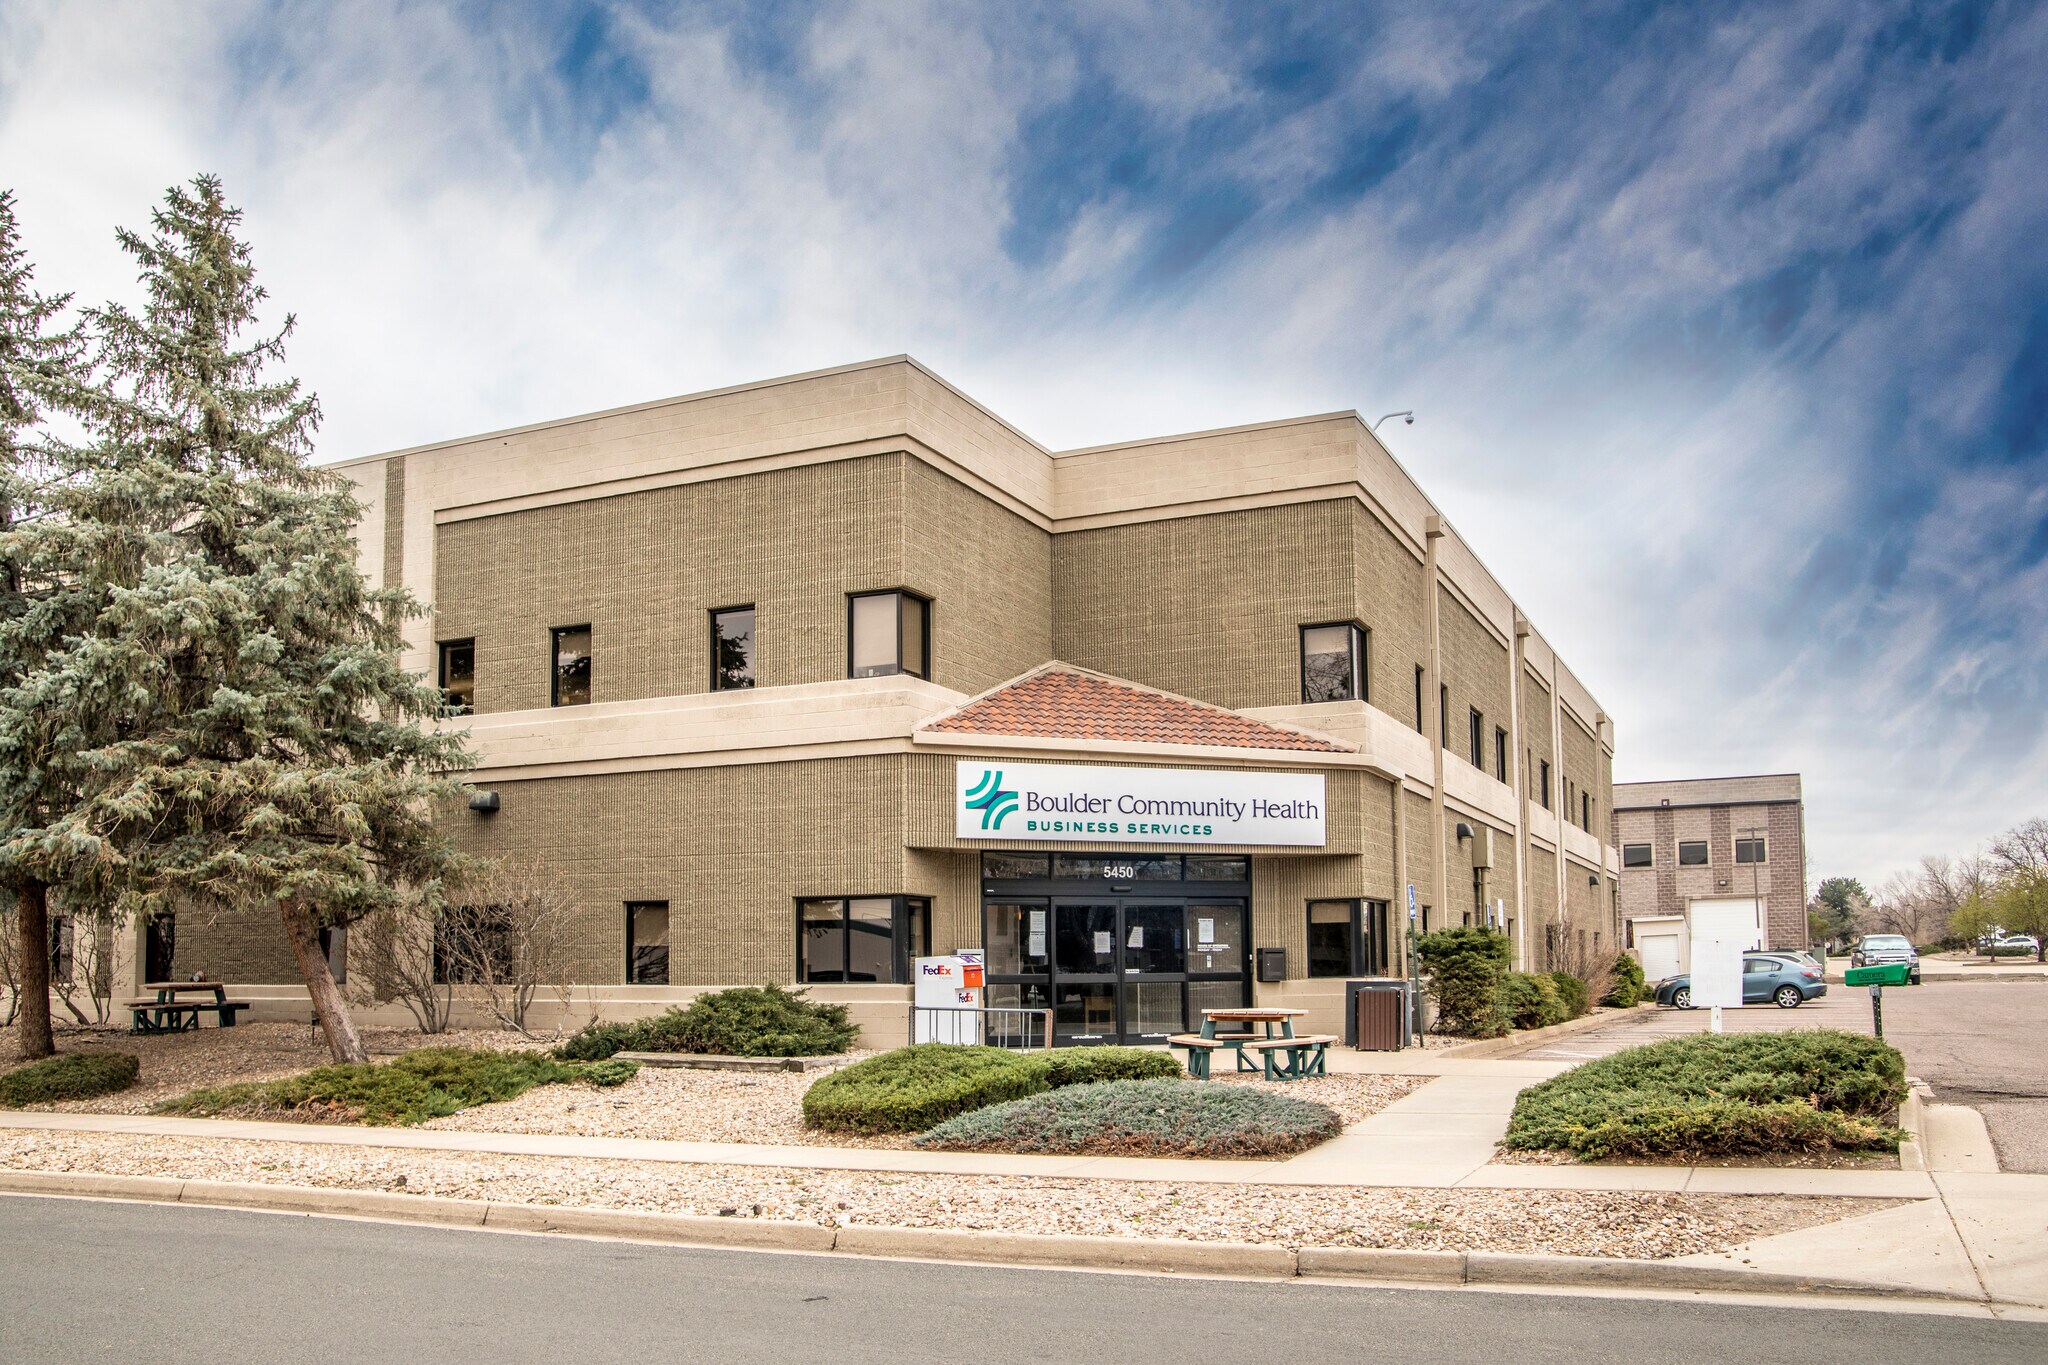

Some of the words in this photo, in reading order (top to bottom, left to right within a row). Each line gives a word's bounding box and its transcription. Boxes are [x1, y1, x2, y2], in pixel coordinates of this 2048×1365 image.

[1026, 791, 1112, 814] Boulder
[1118, 794, 1247, 822] Community
[1252, 798, 1319, 819] Health
[1027, 820, 1119, 833] BUSINESS
[1127, 823, 1213, 836] SERVICES
[1103, 866, 1134, 878] 5450
[923, 964, 952, 975] FedEx
[1856, 970, 1886, 980] Camera
[958, 992, 974, 1003] FedEx
